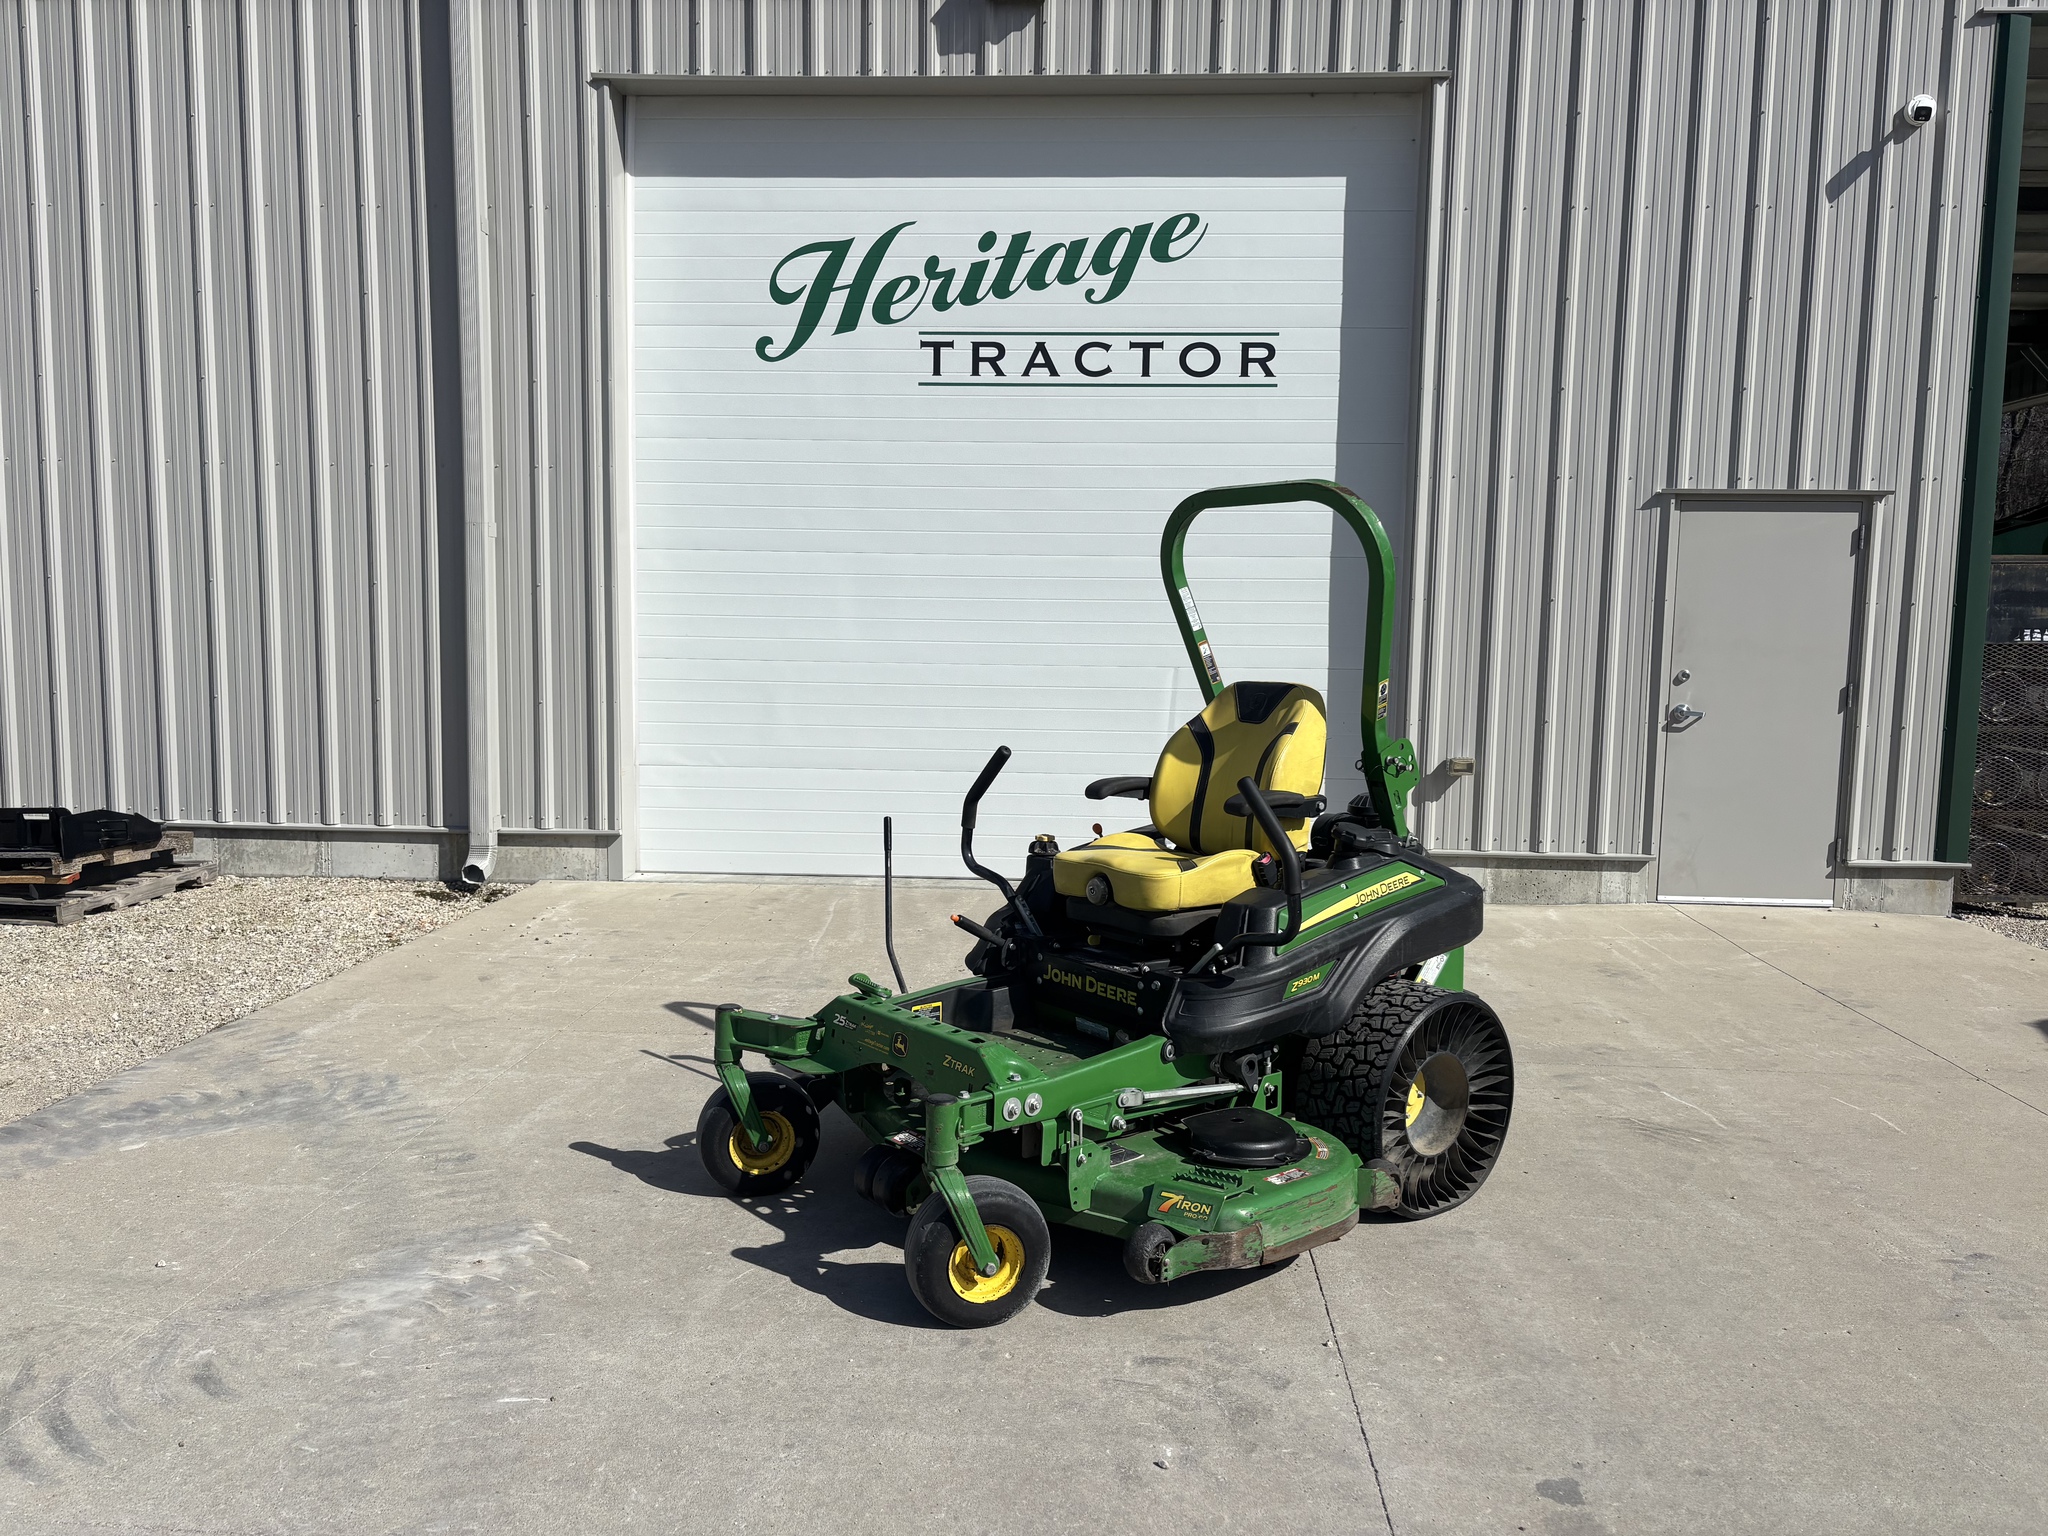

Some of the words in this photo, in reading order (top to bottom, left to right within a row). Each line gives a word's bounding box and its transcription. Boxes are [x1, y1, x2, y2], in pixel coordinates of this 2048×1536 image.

[755, 212, 1209, 362] Heritage
[919, 339, 1277, 378] TRACTOR
[1355, 888, 1380, 906] JOHN
[1379, 875, 1410, 895] DEERE
[1043, 964, 1082, 990] JOHN
[1085, 975, 1138, 1007] DEERE
[1291, 972, 1321, 992] Z930M
[832, 1013, 847, 1027] 25
[942, 1054, 976, 1078] ZTRAK
